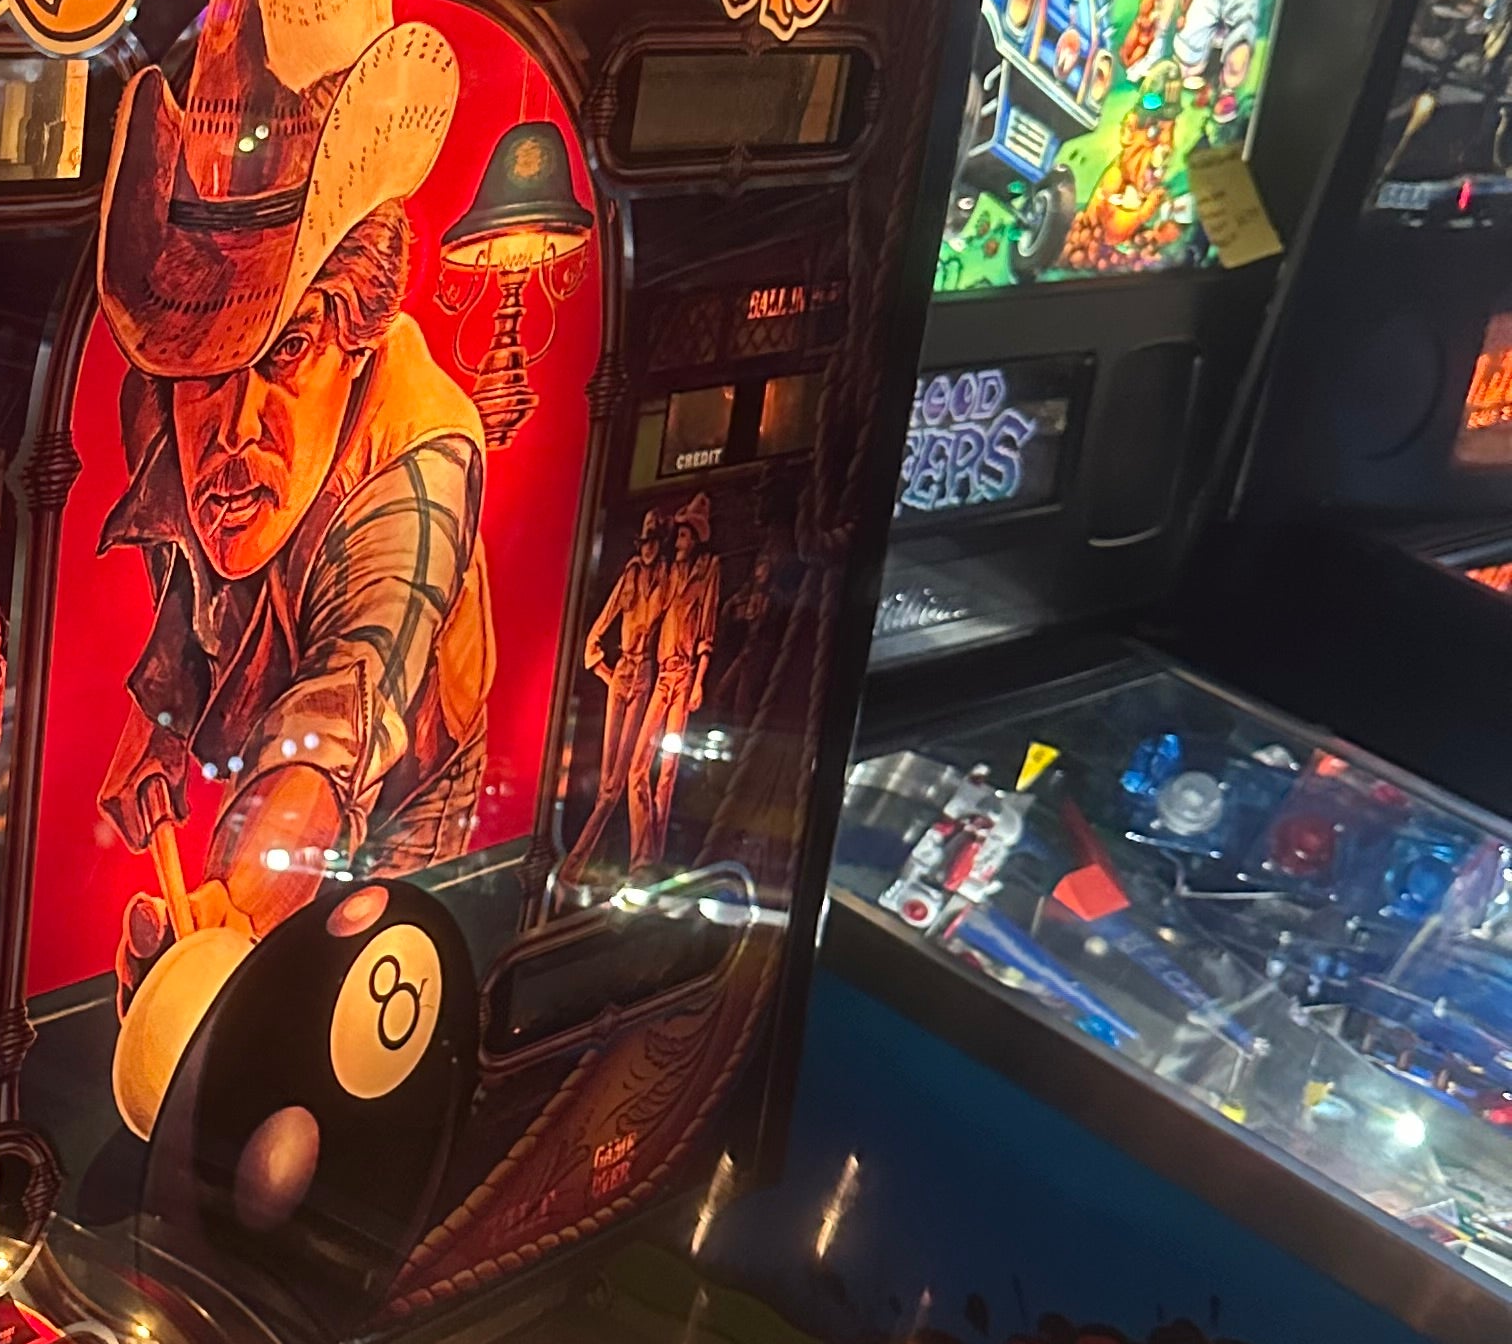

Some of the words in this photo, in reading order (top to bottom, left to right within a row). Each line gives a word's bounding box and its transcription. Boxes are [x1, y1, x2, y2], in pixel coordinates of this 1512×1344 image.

[747, 288, 787, 320] BALL
[675, 447, 724, 470] CREDIT
[368, 954, 420, 1051] 8
[593, 1131, 638, 1169] GAME
